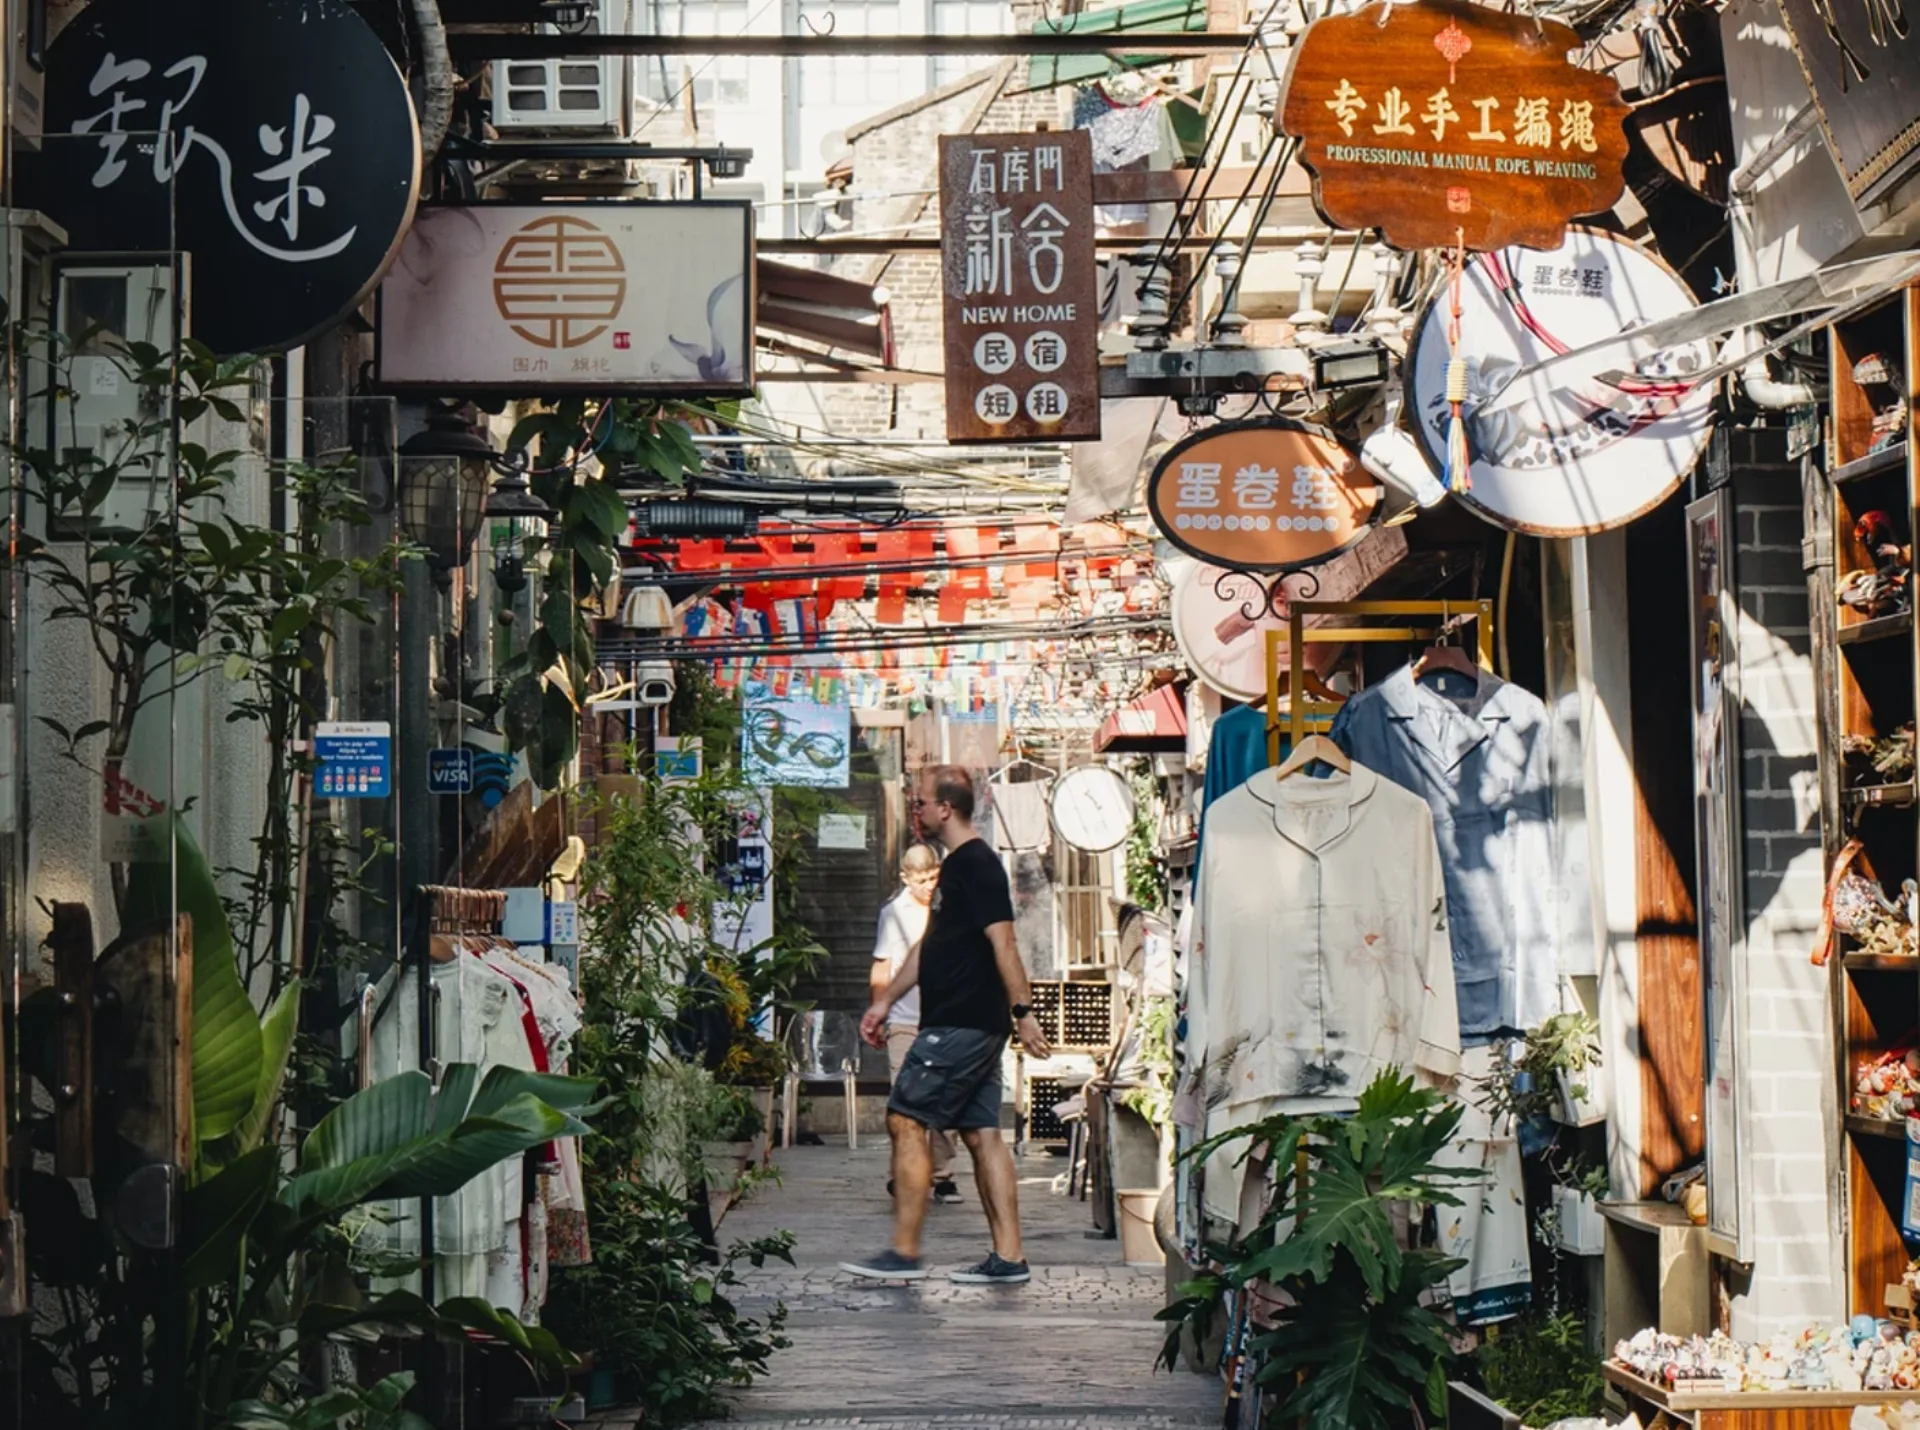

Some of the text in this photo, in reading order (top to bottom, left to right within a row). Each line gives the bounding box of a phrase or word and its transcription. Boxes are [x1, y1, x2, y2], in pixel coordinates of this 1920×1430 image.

[1325, 78, 1598, 153] 专业手工编绳
[1326, 144, 1597, 181] PROFESSIONAL MANUAL ROPE WEAVING
[962, 303, 1077, 325] NEW HOME
[980, 336, 1061, 369] 民宿
[981, 387, 1062, 419] 短租
[1175, 462, 1339, 510] 蛋卷鞋
[433, 769, 469, 783] VISA
